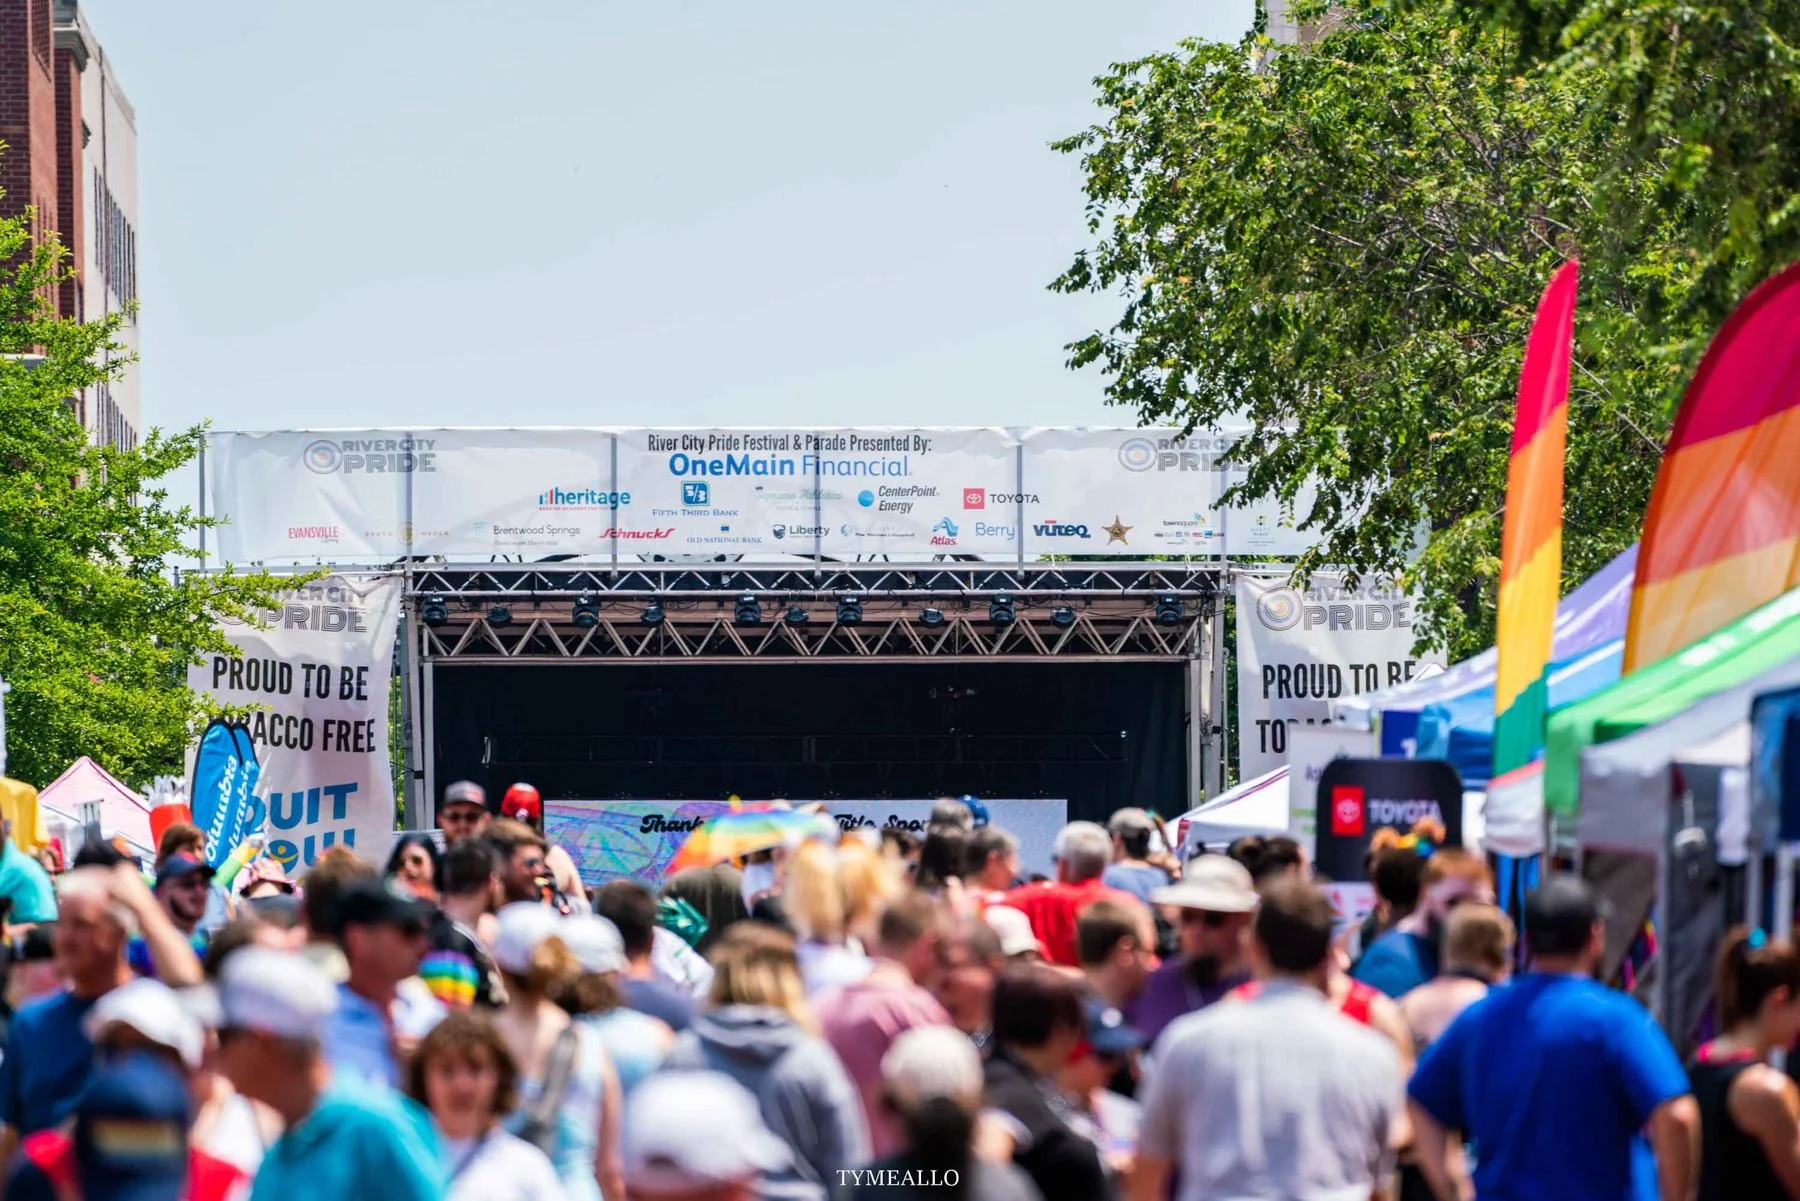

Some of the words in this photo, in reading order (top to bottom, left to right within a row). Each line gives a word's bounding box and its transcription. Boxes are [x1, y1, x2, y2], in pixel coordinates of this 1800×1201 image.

[342, 439, 397, 452] RIVER
[398, 438, 436, 451] CITY
[648, 434, 679, 451] River
[682, 434, 705, 455] City
[708, 434, 740, 451] Pride
[743, 434, 789, 451] Festival
[793, 434, 802, 451] &
[805, 434, 846, 451] Parade
[850, 434, 909, 452] Presented
[913, 435, 932, 455] By:
[343, 453, 437, 474] PRIDE
[668, 453, 795, 477] OneMain
[802, 454, 910, 477] Financial
[555, 486, 631, 511] heritage
[878, 485, 936, 497] CenterPoint
[989, 493, 1040, 504] TOYOTA
[652, 508, 678, 517] FIFTH
[681, 508, 710, 517] THIRD
[713, 508, 739, 517] BANK
[878, 500, 914, 514] Energy
[288, 526, 339, 539] EVANSVILLE
[493, 525, 545, 536] Brentwood
[546, 525, 581, 538] Springs
[599, 528, 676, 539] Schnucks
[789, 525, 831, 537] Liberty
[930, 536, 956, 546] Atlas
[976, 522, 1015, 540] Berry
[259, 603, 367, 633] PRIDE
[1303, 602, 1411, 631] PRIDE
[213, 656, 292, 695] PROUD
[301, 664, 331, 700] TO
[339, 666, 369, 701] BE
[1262, 663, 1342, 699] PROUD
[1349, 663, 1379, 696] TO
[322, 718, 376, 753] FREE
[206, 755, 238, 862] olumbia
[1367, 799, 1444, 824] TOYOTA
[640, 814, 705, 834] Thank
